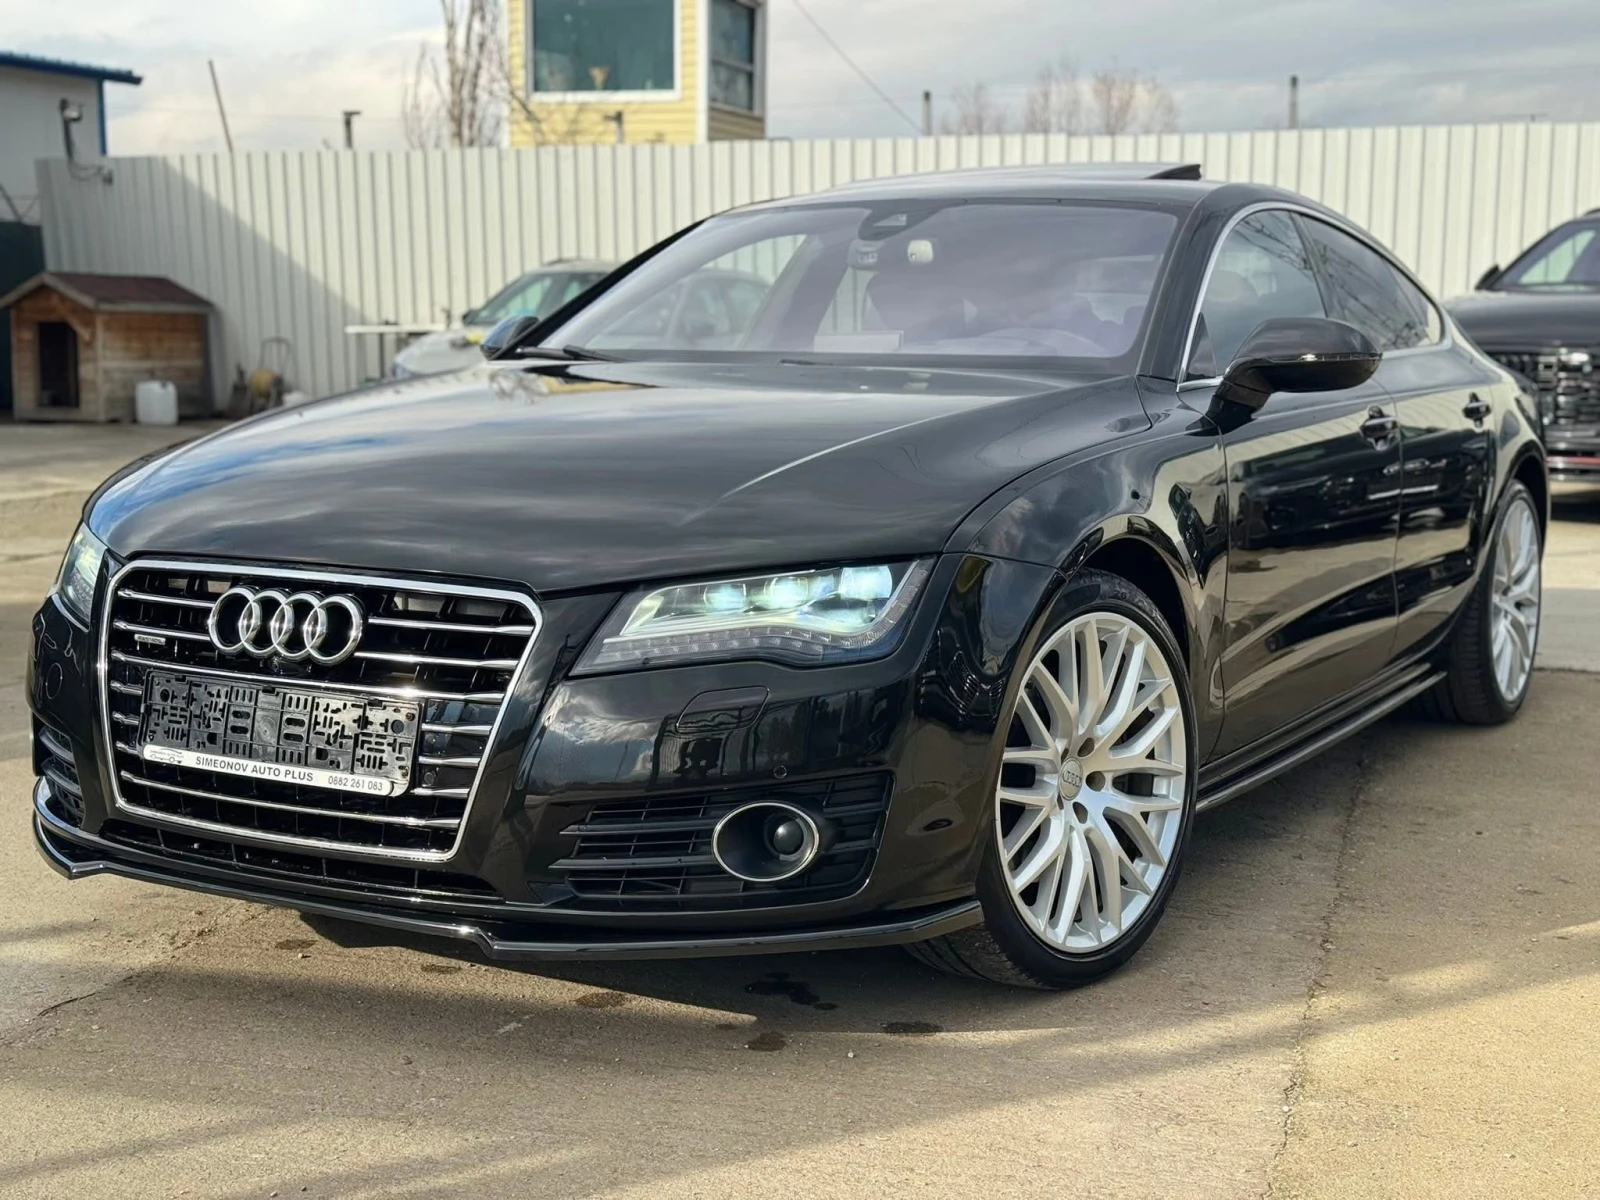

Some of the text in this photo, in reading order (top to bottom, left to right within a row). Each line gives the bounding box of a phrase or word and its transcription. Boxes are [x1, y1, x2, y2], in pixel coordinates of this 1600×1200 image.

[195, 756, 383, 792] SIMEONOV AUTO PLUS 0882 261 083
